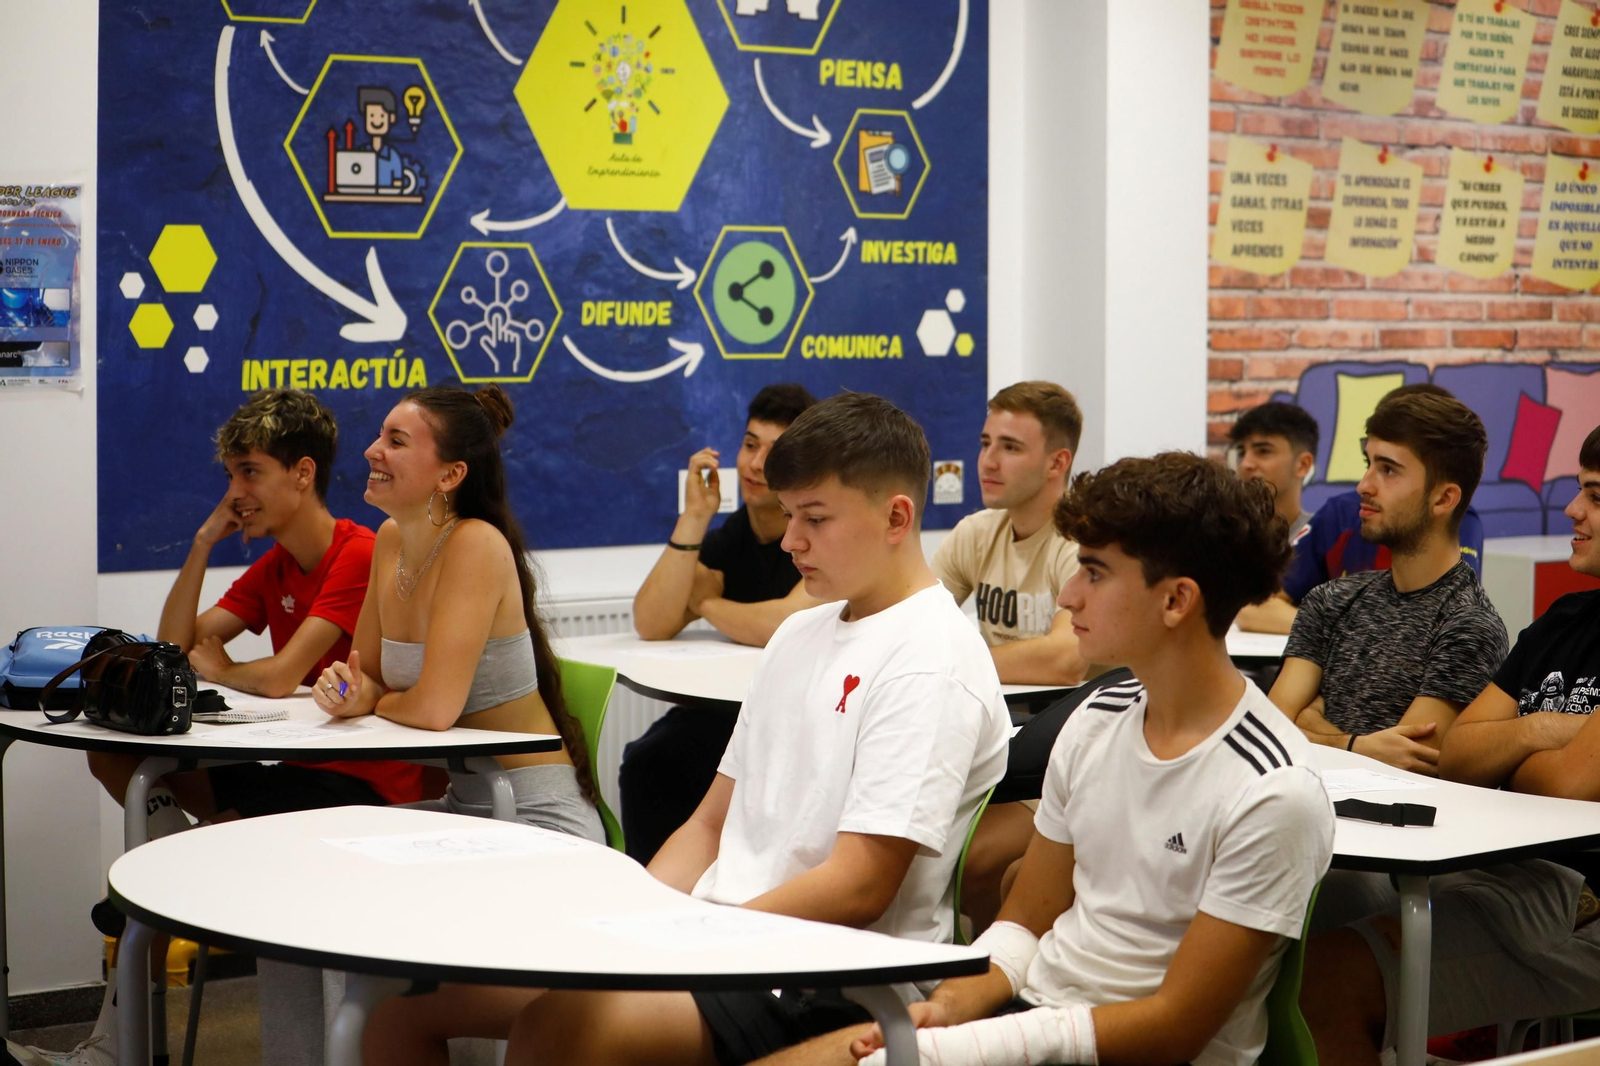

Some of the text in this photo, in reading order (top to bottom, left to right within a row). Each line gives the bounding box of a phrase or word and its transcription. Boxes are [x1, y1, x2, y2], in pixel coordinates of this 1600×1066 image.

[1564, 25, 1580, 37] CREE
[1571, 46, 1584, 59] QUE
[819, 58, 903, 90] PIENSA
[1562, 105, 1599, 120] DE SUCEDER
[1231, 172, 1287, 187] UNA VECES
[25, 185, 78, 198] LEAGUE
[1473, 183, 1502, 193] CREES
[1556, 183, 1567, 194] LO
[1271, 197, 1303, 211] OTRAS
[1451, 199, 1469, 211] QUE
[1232, 220, 1263, 233] VECES
[1549, 220, 1560, 231] ES
[26, 237, 34, 246] DE
[38, 237, 61, 246] ENERO
[1466, 235, 1495, 245] MEDIO
[1560, 240, 1593, 253] QUE NO
[860, 239, 958, 265] INVESTIGA
[1232, 244, 1284, 258] APRENDES
[6, 258, 39, 266] NIPPON
[6, 266, 33, 274] GASES
[581, 301, 672, 326] DIFUNDE
[800, 334, 903, 359] COMUNICA
[242, 349, 427, 391] INTERACTÚA
[1164, 842, 1187, 854] adidas
